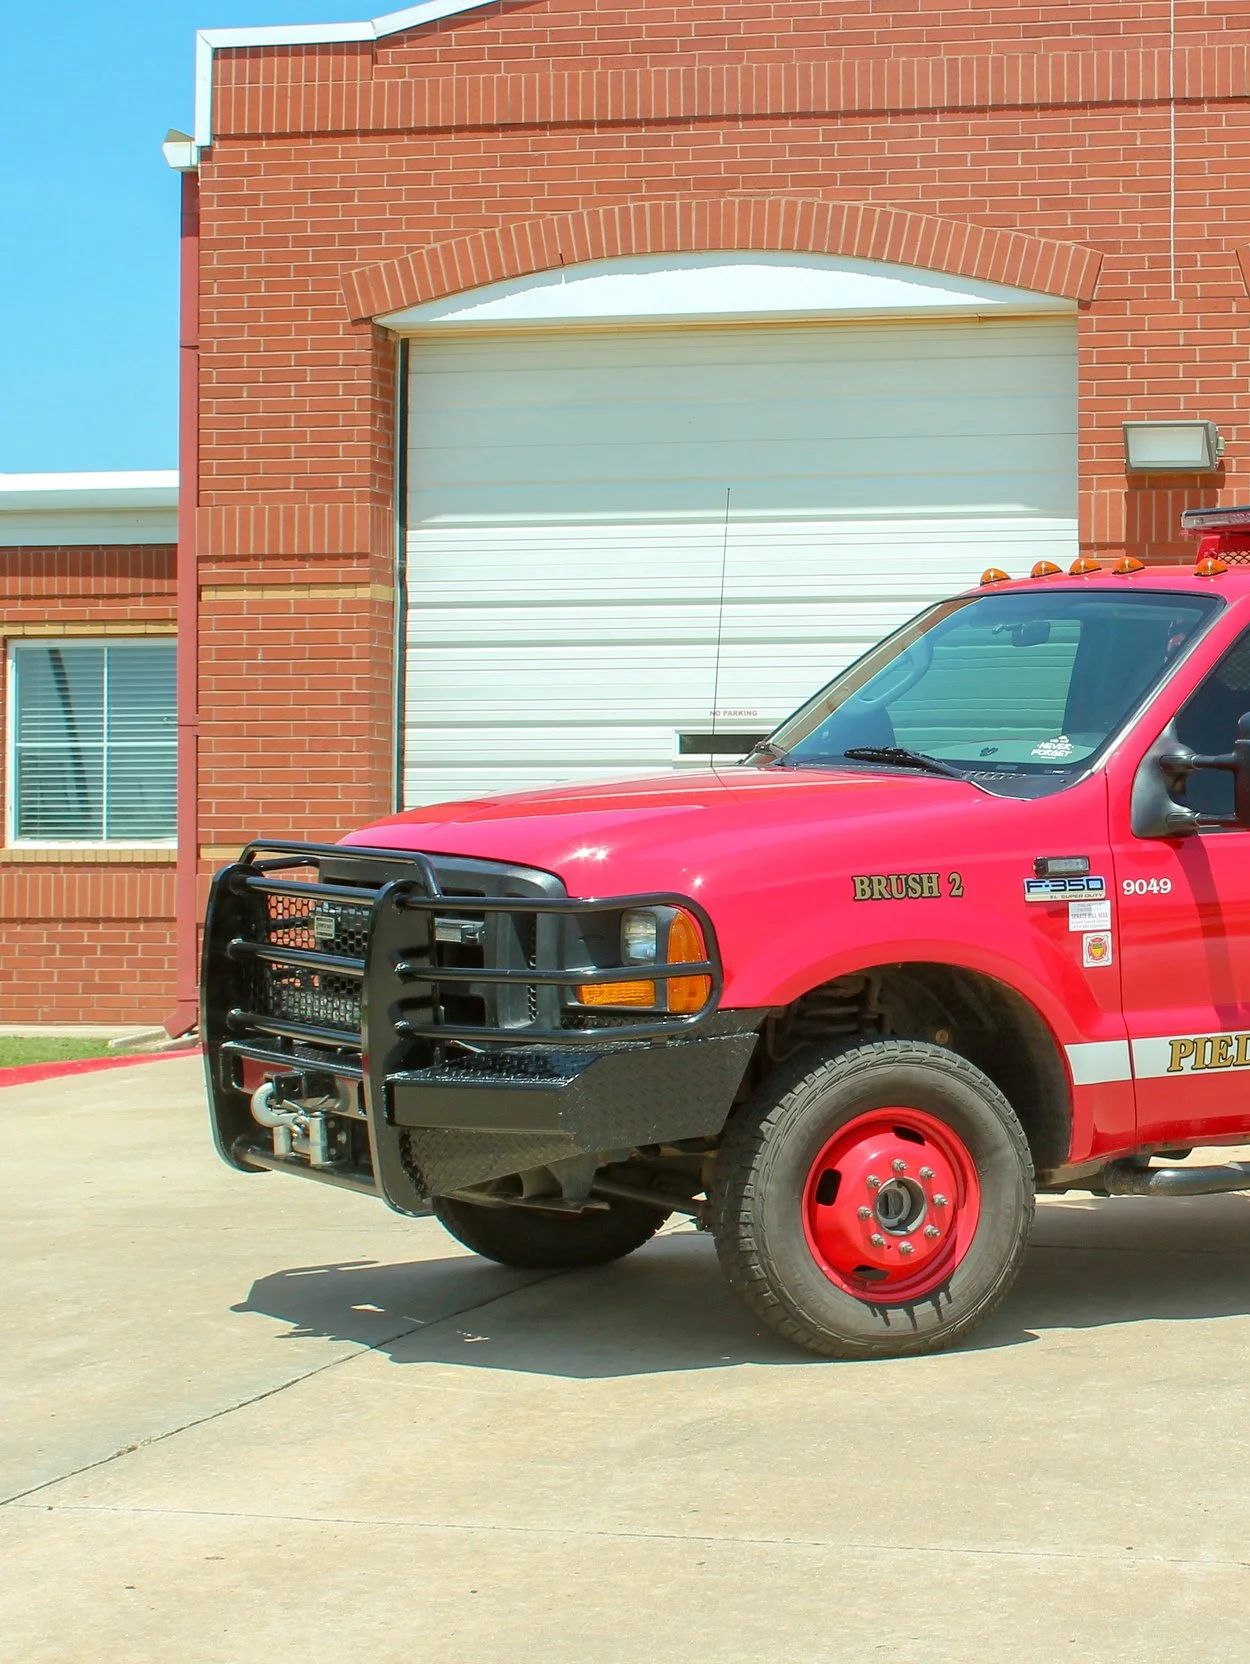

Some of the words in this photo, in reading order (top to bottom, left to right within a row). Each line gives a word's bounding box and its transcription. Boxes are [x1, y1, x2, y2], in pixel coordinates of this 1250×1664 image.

[1031, 749, 1072, 757] FORGET
[1039, 742, 1072, 751] NEVER
[851, 873, 941, 901] BRUSH
[948, 871, 964, 898] 2
[1026, 878, 1104, 893] F-350
[1122, 878, 1172, 895] 9049
